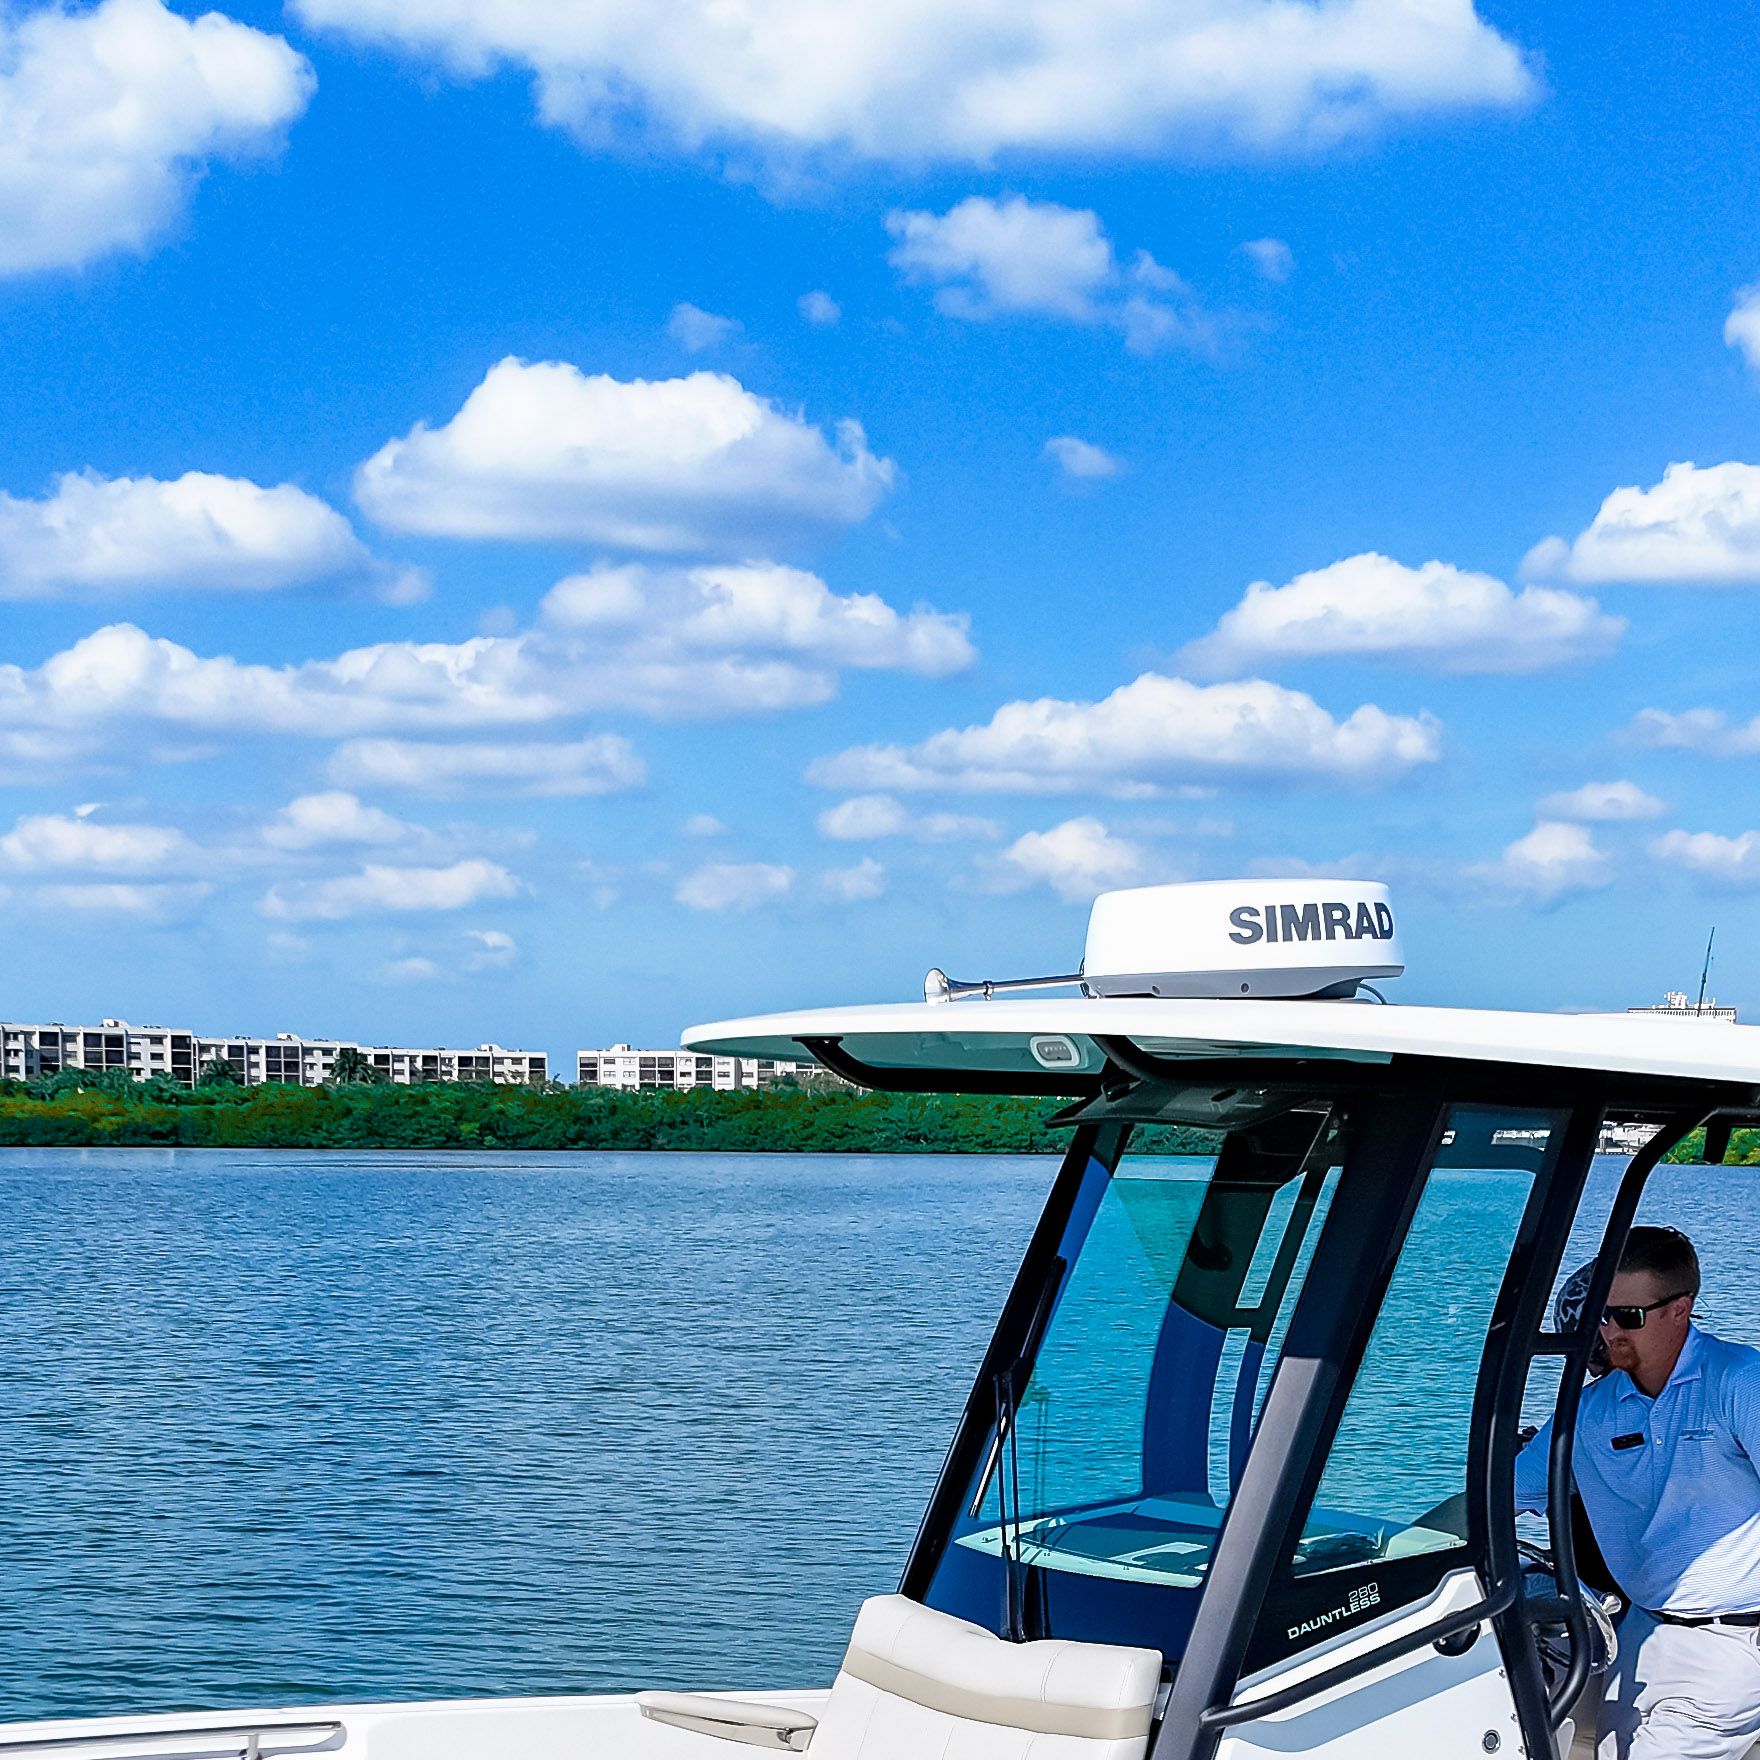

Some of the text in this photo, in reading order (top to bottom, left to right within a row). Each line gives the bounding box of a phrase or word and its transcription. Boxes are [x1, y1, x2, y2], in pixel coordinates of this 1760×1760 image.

[1229, 902, 1393, 945] SIMRAD
[1349, 1582, 1378, 1602] 280
[1287, 1594, 1380, 1639] DAUNTLESS
